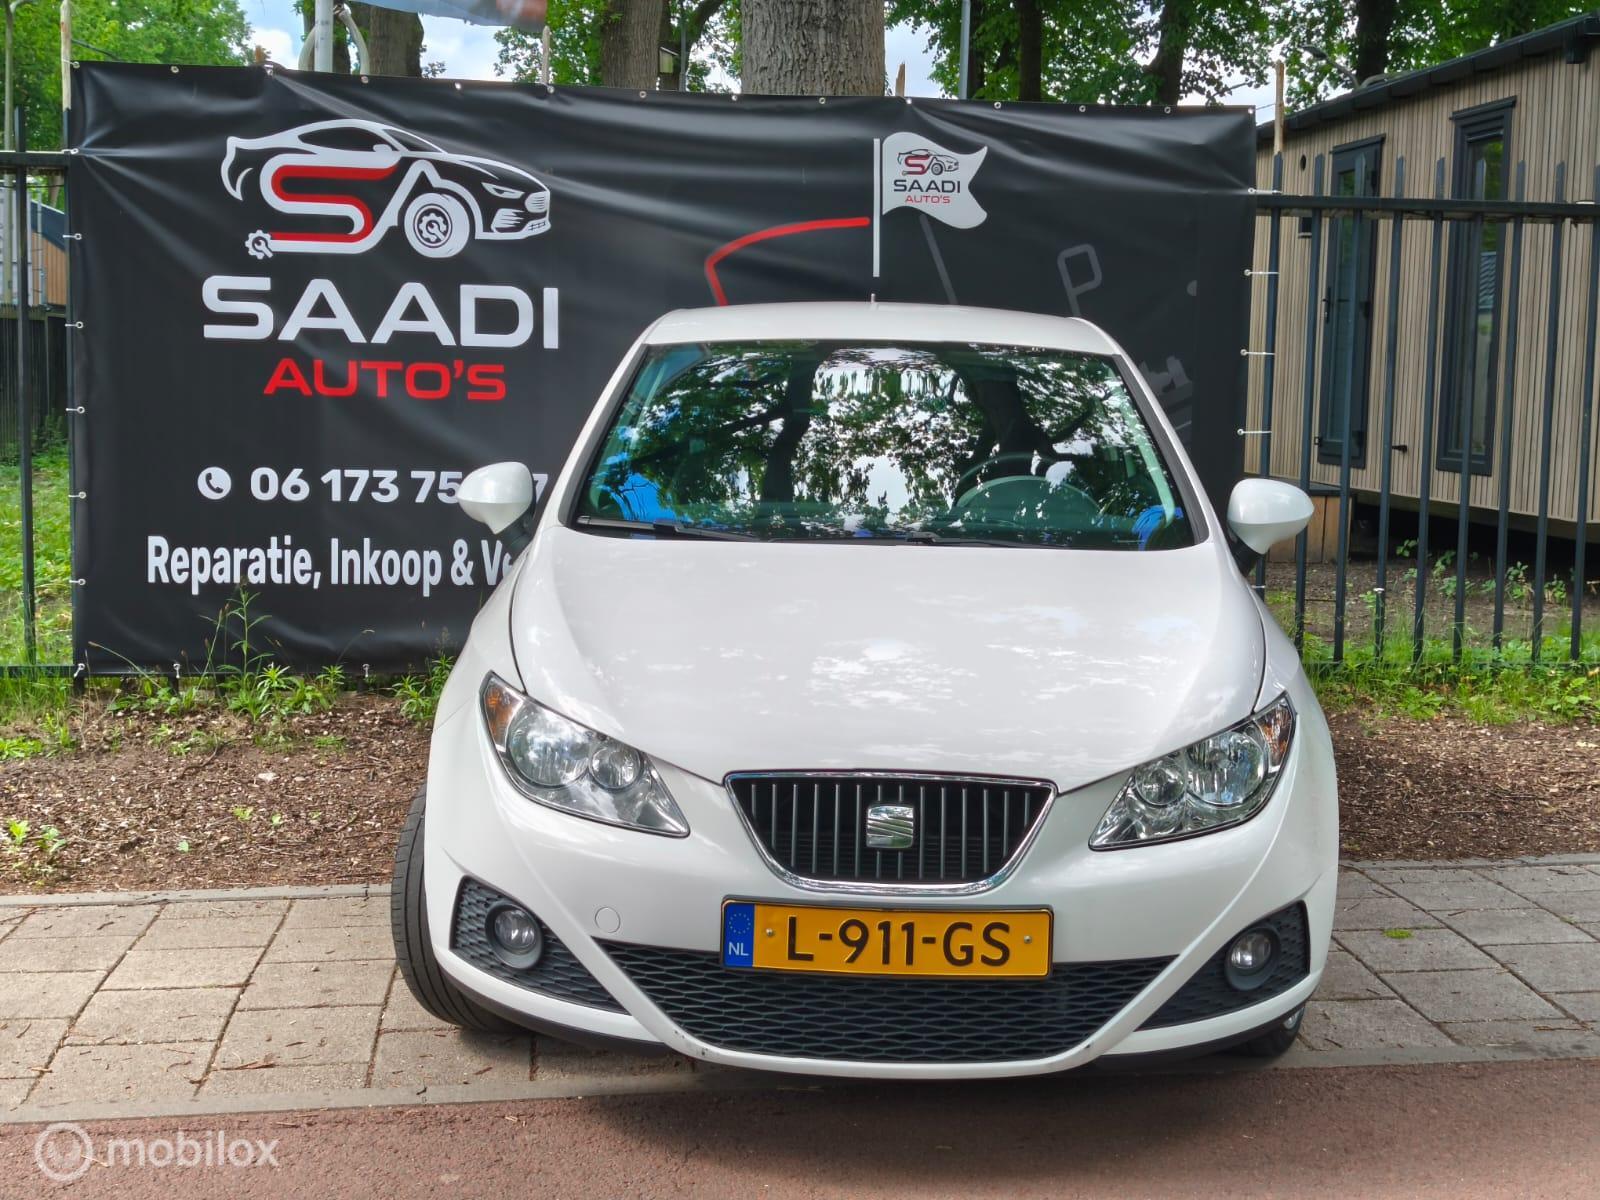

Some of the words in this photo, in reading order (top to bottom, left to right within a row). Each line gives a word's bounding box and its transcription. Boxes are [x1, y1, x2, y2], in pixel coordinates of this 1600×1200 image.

[893, 179, 961, 193] SAADI
[905, 195, 950, 204] AUTO'S
[202, 275, 559, 349] SAADI
[264, 358, 507, 400] AUTO'S
[250, 467, 309, 500] 06
[321, 469, 399, 503] 173
[147, 535, 321, 595] Reparatie,
[330, 538, 443, 597] Inkoop
[451, 539, 474, 586] &
[728, 942, 749, 957] NL
[787, 916, 1011, 968] L-911-GS
